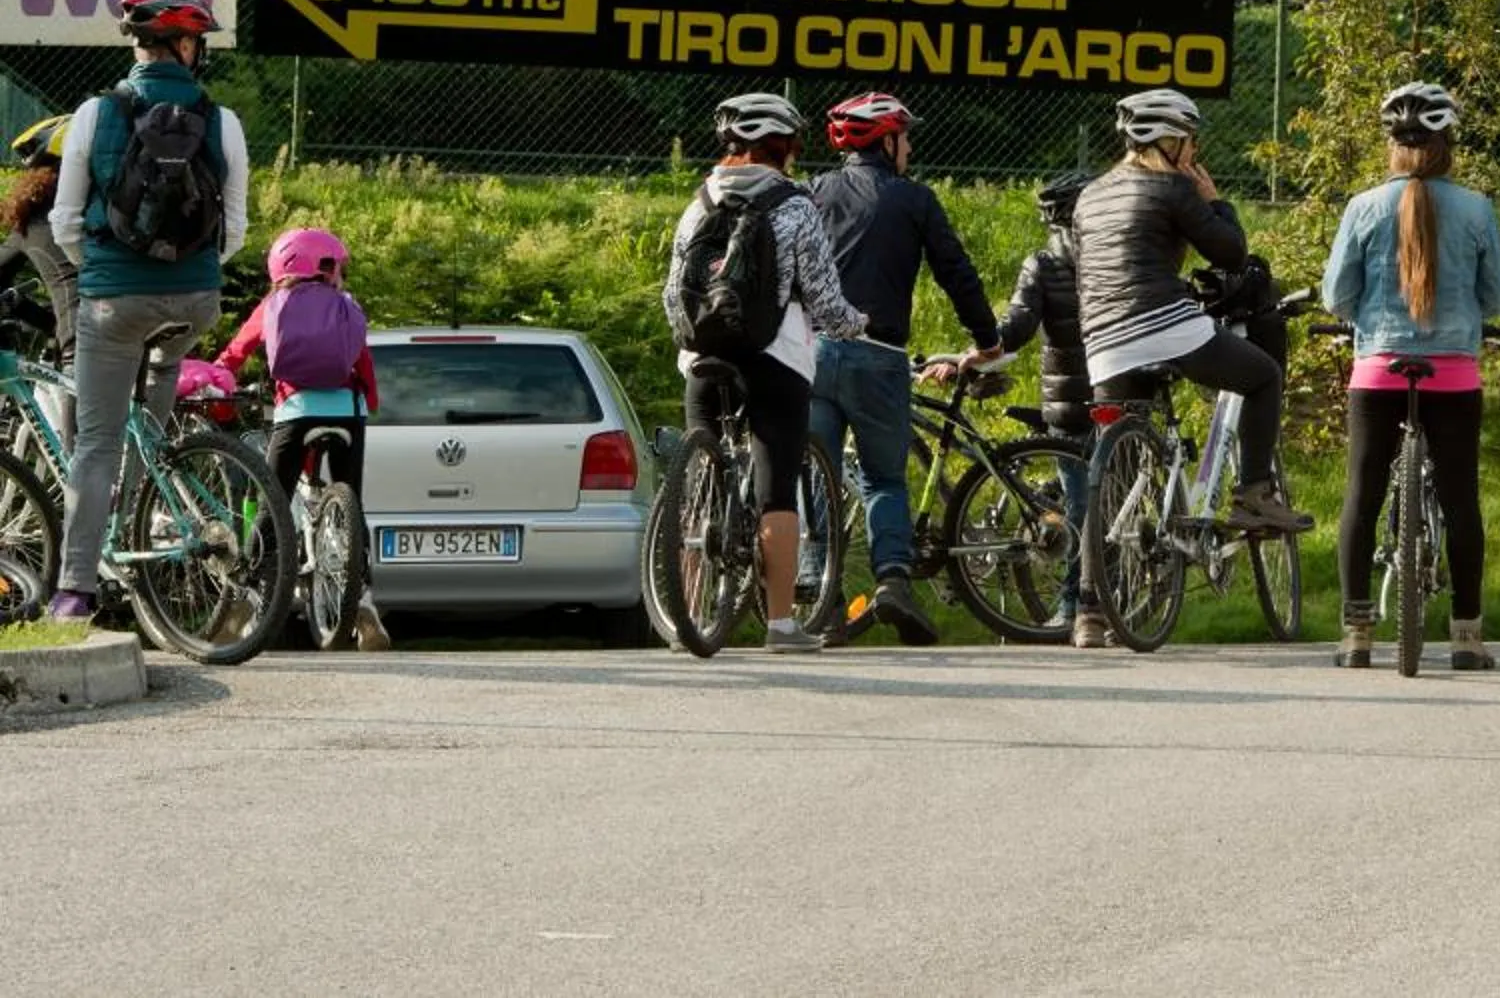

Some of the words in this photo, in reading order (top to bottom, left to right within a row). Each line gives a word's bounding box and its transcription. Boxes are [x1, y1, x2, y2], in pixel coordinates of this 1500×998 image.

[613, 7, 779, 67] TIRO
[795, 15, 954, 73] CON
[967, 23, 1226, 88] L'ARCO
